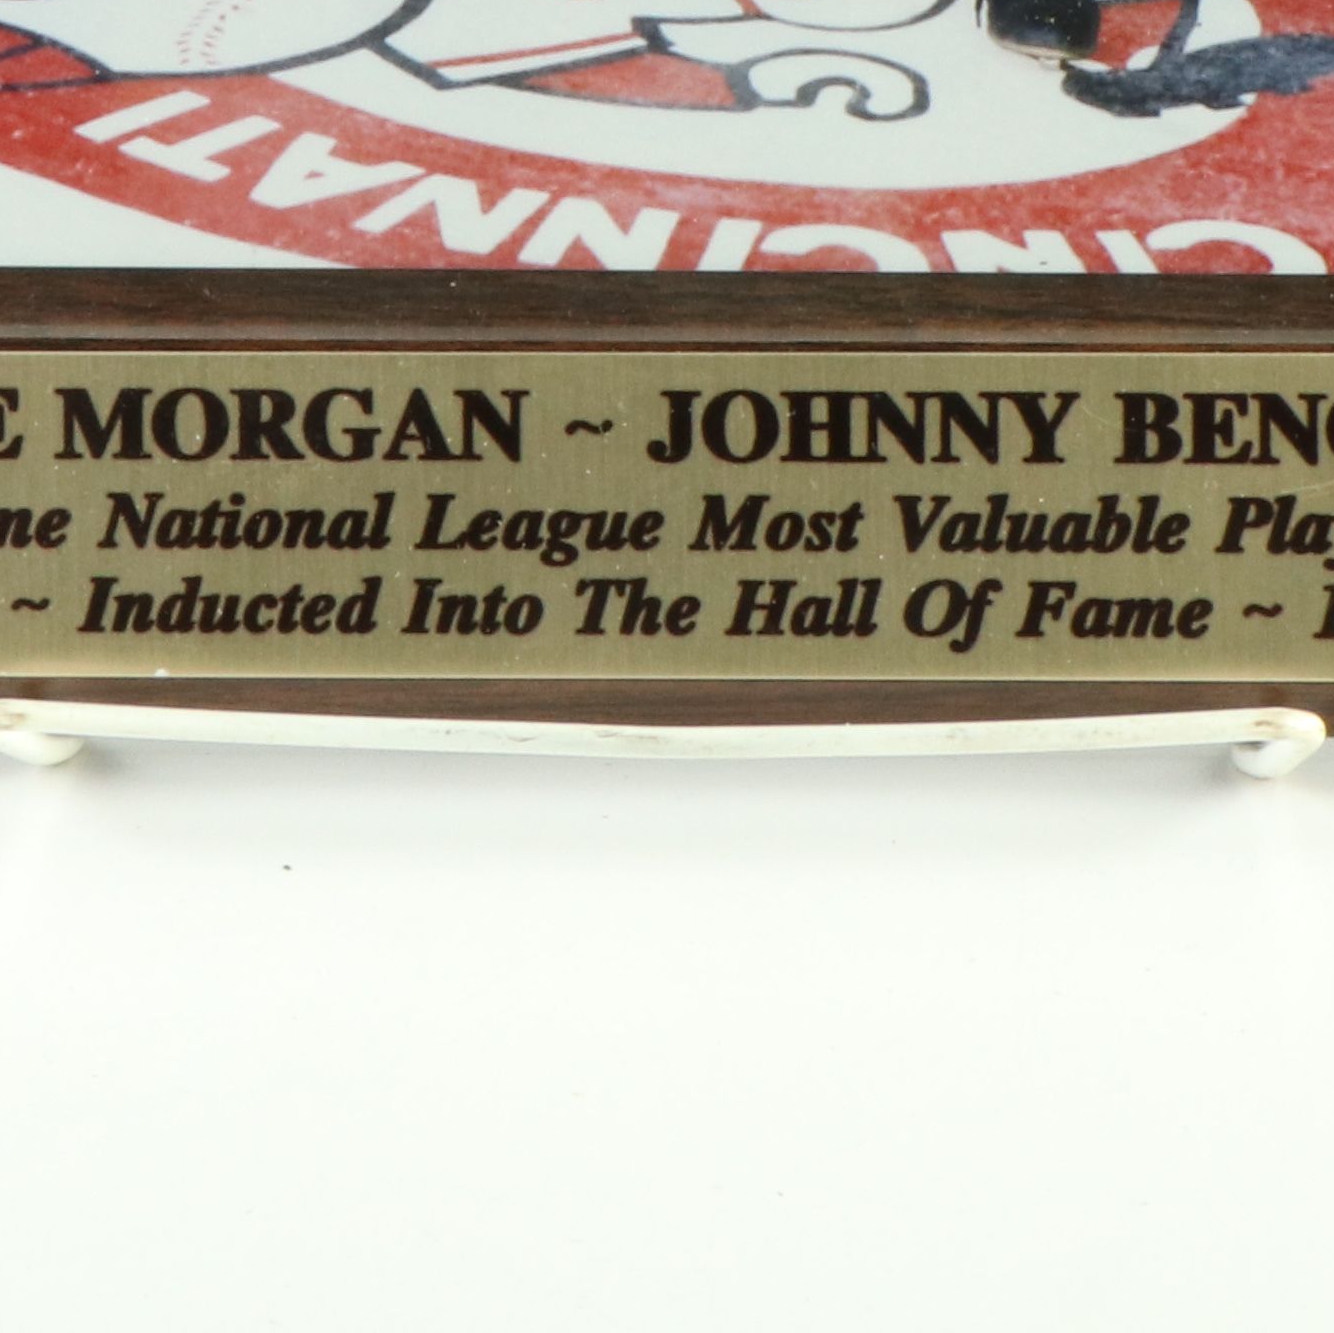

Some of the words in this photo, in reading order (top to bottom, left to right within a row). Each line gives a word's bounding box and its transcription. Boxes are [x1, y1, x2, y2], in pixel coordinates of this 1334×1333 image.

[53, 386, 532, 465] MORGAN
[645, 387, 1082, 466] JOHNNY
[96, 489, 396, 552] National
[413, 491, 665, 570] League
[687, 492, 866, 554] Most
[892, 491, 1192, 556] Valuable
[77, 574, 383, 636] Inducted
[400, 576, 544, 638] Into
[574, 576, 703, 638] The
[724, 577, 883, 639] Hall
[902, 577, 1003, 655] Of
[1012, 577, 1215, 641] Fame
